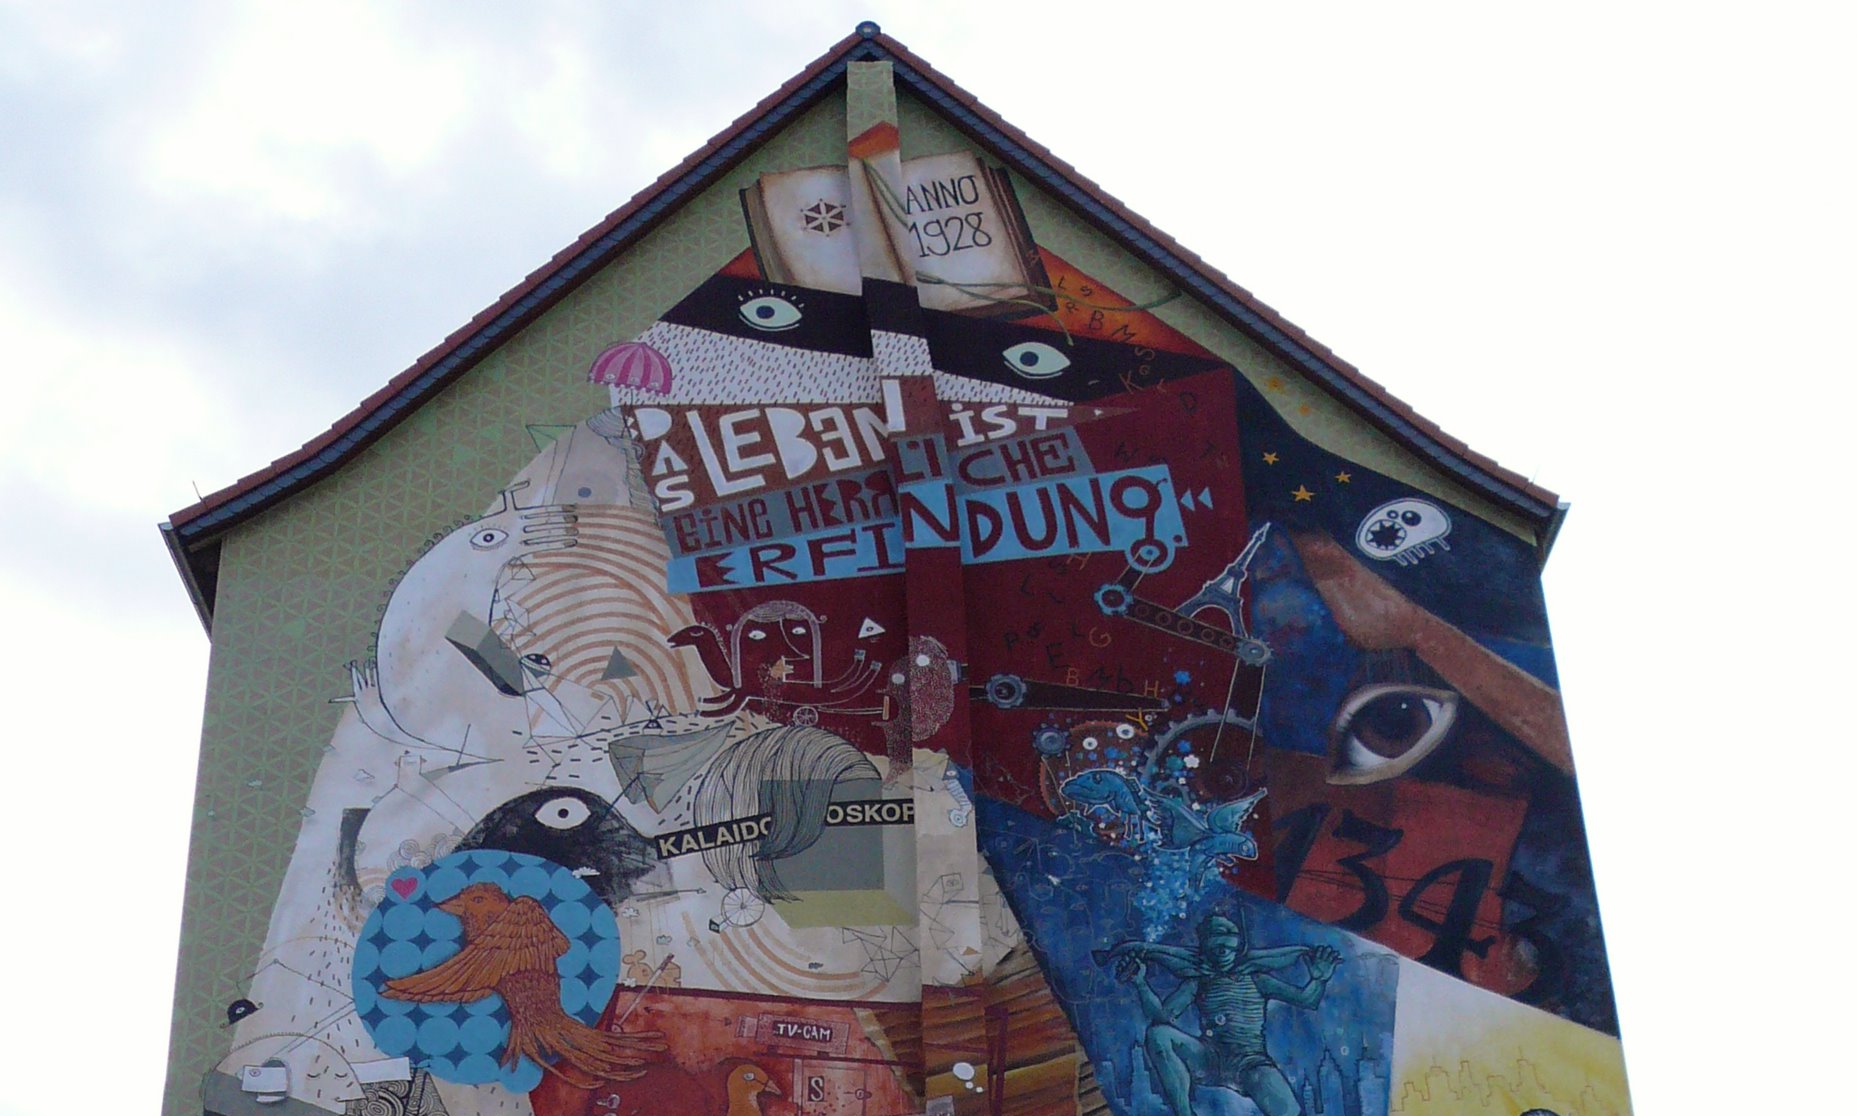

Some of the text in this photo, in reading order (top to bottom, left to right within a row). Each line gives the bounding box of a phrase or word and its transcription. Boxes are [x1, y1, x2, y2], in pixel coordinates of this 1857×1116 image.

[905, 174, 980, 215] ANNO
[908, 211, 992, 257] 1928
[685, 378, 906, 497] LEBEN
[776, 1022, 832, 1042] TV-CAM
[810, 1076, 825, 1102] S
